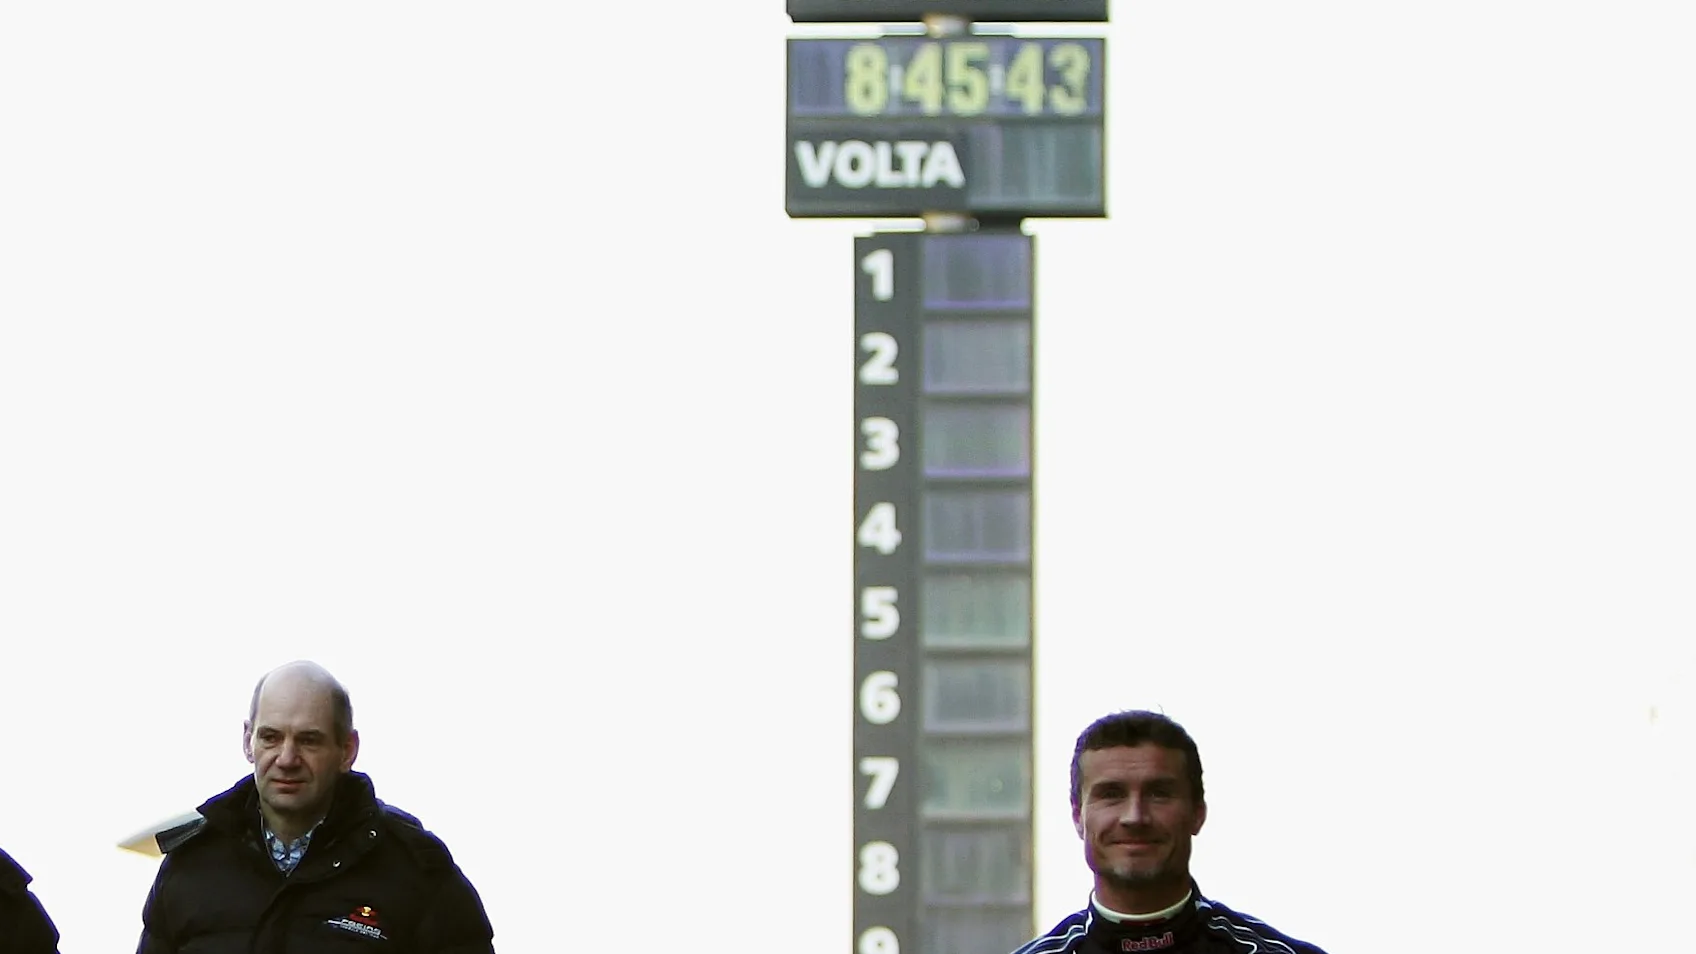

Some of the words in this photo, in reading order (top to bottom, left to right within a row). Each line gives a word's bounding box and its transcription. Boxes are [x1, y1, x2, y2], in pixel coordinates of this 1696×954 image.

[794, 140, 965, 189] VOLTA
[861, 249, 894, 300] 1
[860, 332, 899, 385] 2
[861, 417, 900, 470] 3
[857, 502, 902, 554] 4
[861, 586, 900, 639] 5
[860, 671, 901, 724] 6
[860, 757, 899, 809] 7
[859, 841, 900, 895] 8
